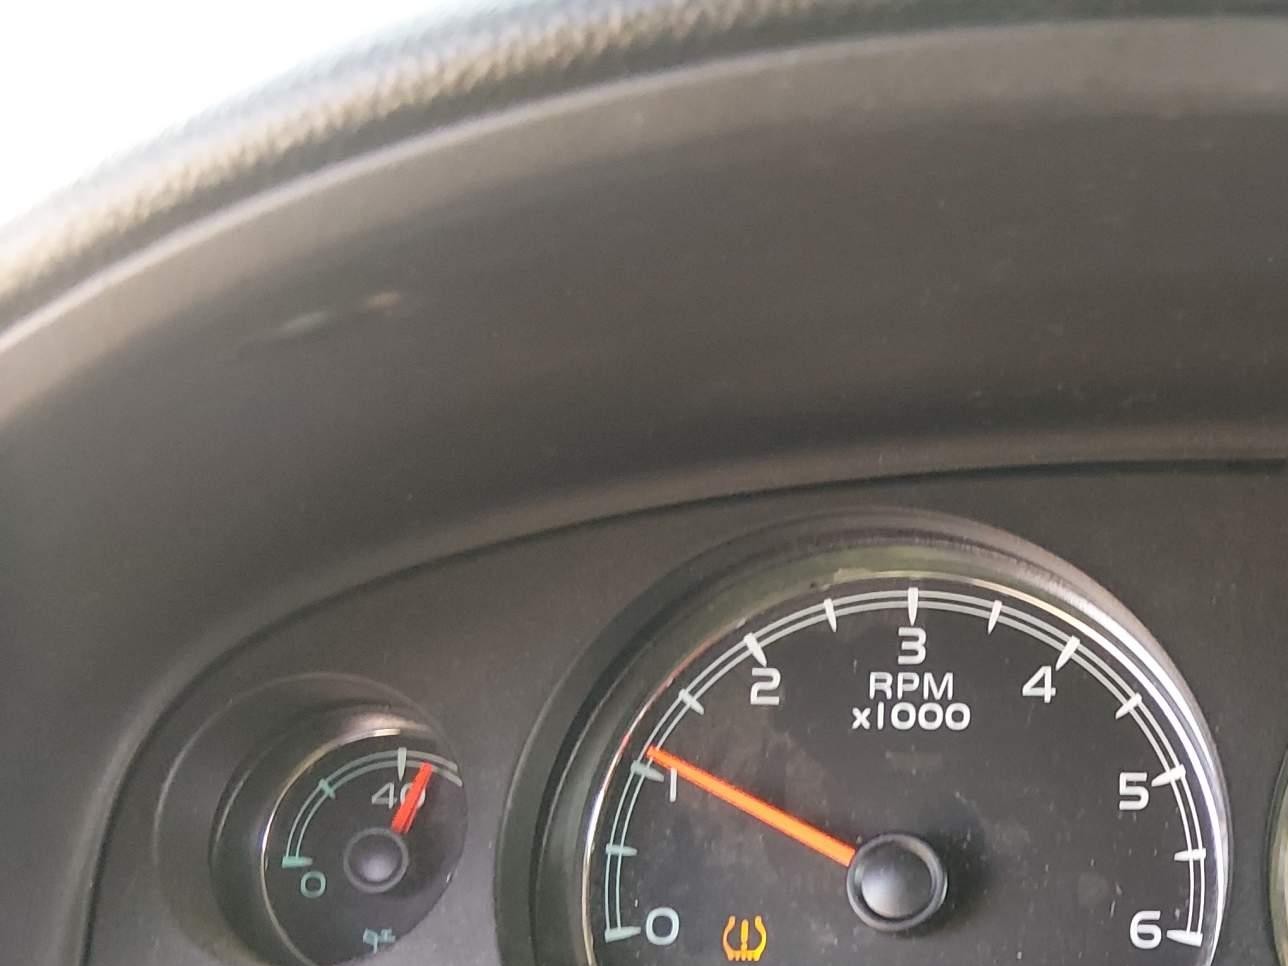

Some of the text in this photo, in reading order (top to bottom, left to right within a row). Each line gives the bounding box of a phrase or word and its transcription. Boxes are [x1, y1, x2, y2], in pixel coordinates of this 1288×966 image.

[898, 627, 927, 665] 3
[750, 668, 780, 705] 2
[869, 671, 954, 700] RPM
[1023, 666, 1056, 702] 4
[852, 702, 971, 731] x1000
[371, 782, 426, 810] 40
[669, 767, 678, 802] 1
[1119, 773, 1149, 810] 5
[300, 871, 326, 898] 0
[645, 908, 679, 945] 0
[1130, 911, 1161, 949] 6
